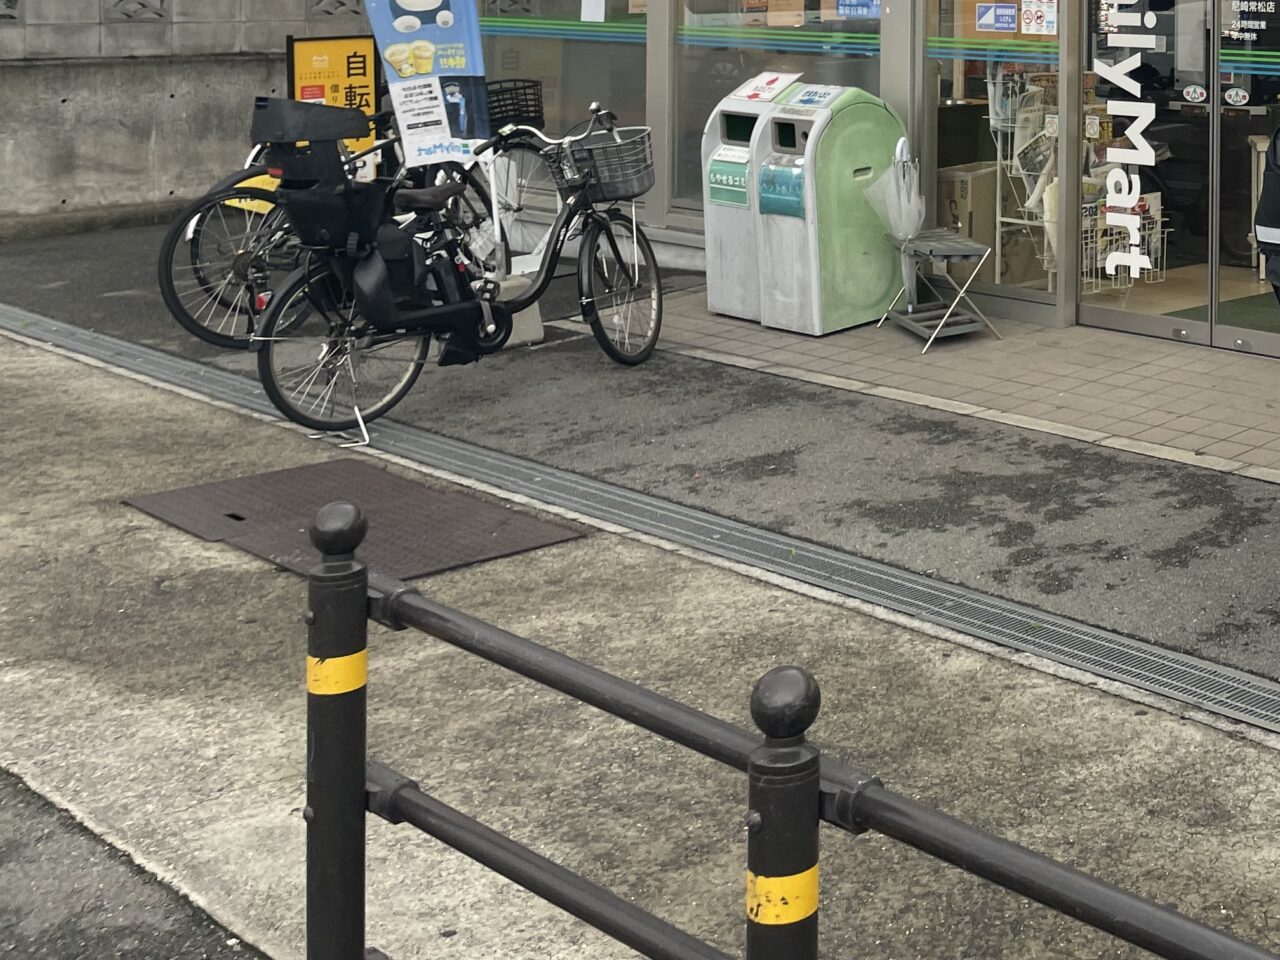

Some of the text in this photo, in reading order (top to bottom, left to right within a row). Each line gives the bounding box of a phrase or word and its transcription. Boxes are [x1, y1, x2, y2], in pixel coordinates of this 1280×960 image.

[1231, 1, 1275, 13] 尼崎常松店
[710, 173, 746, 186] もやせるゴミ
